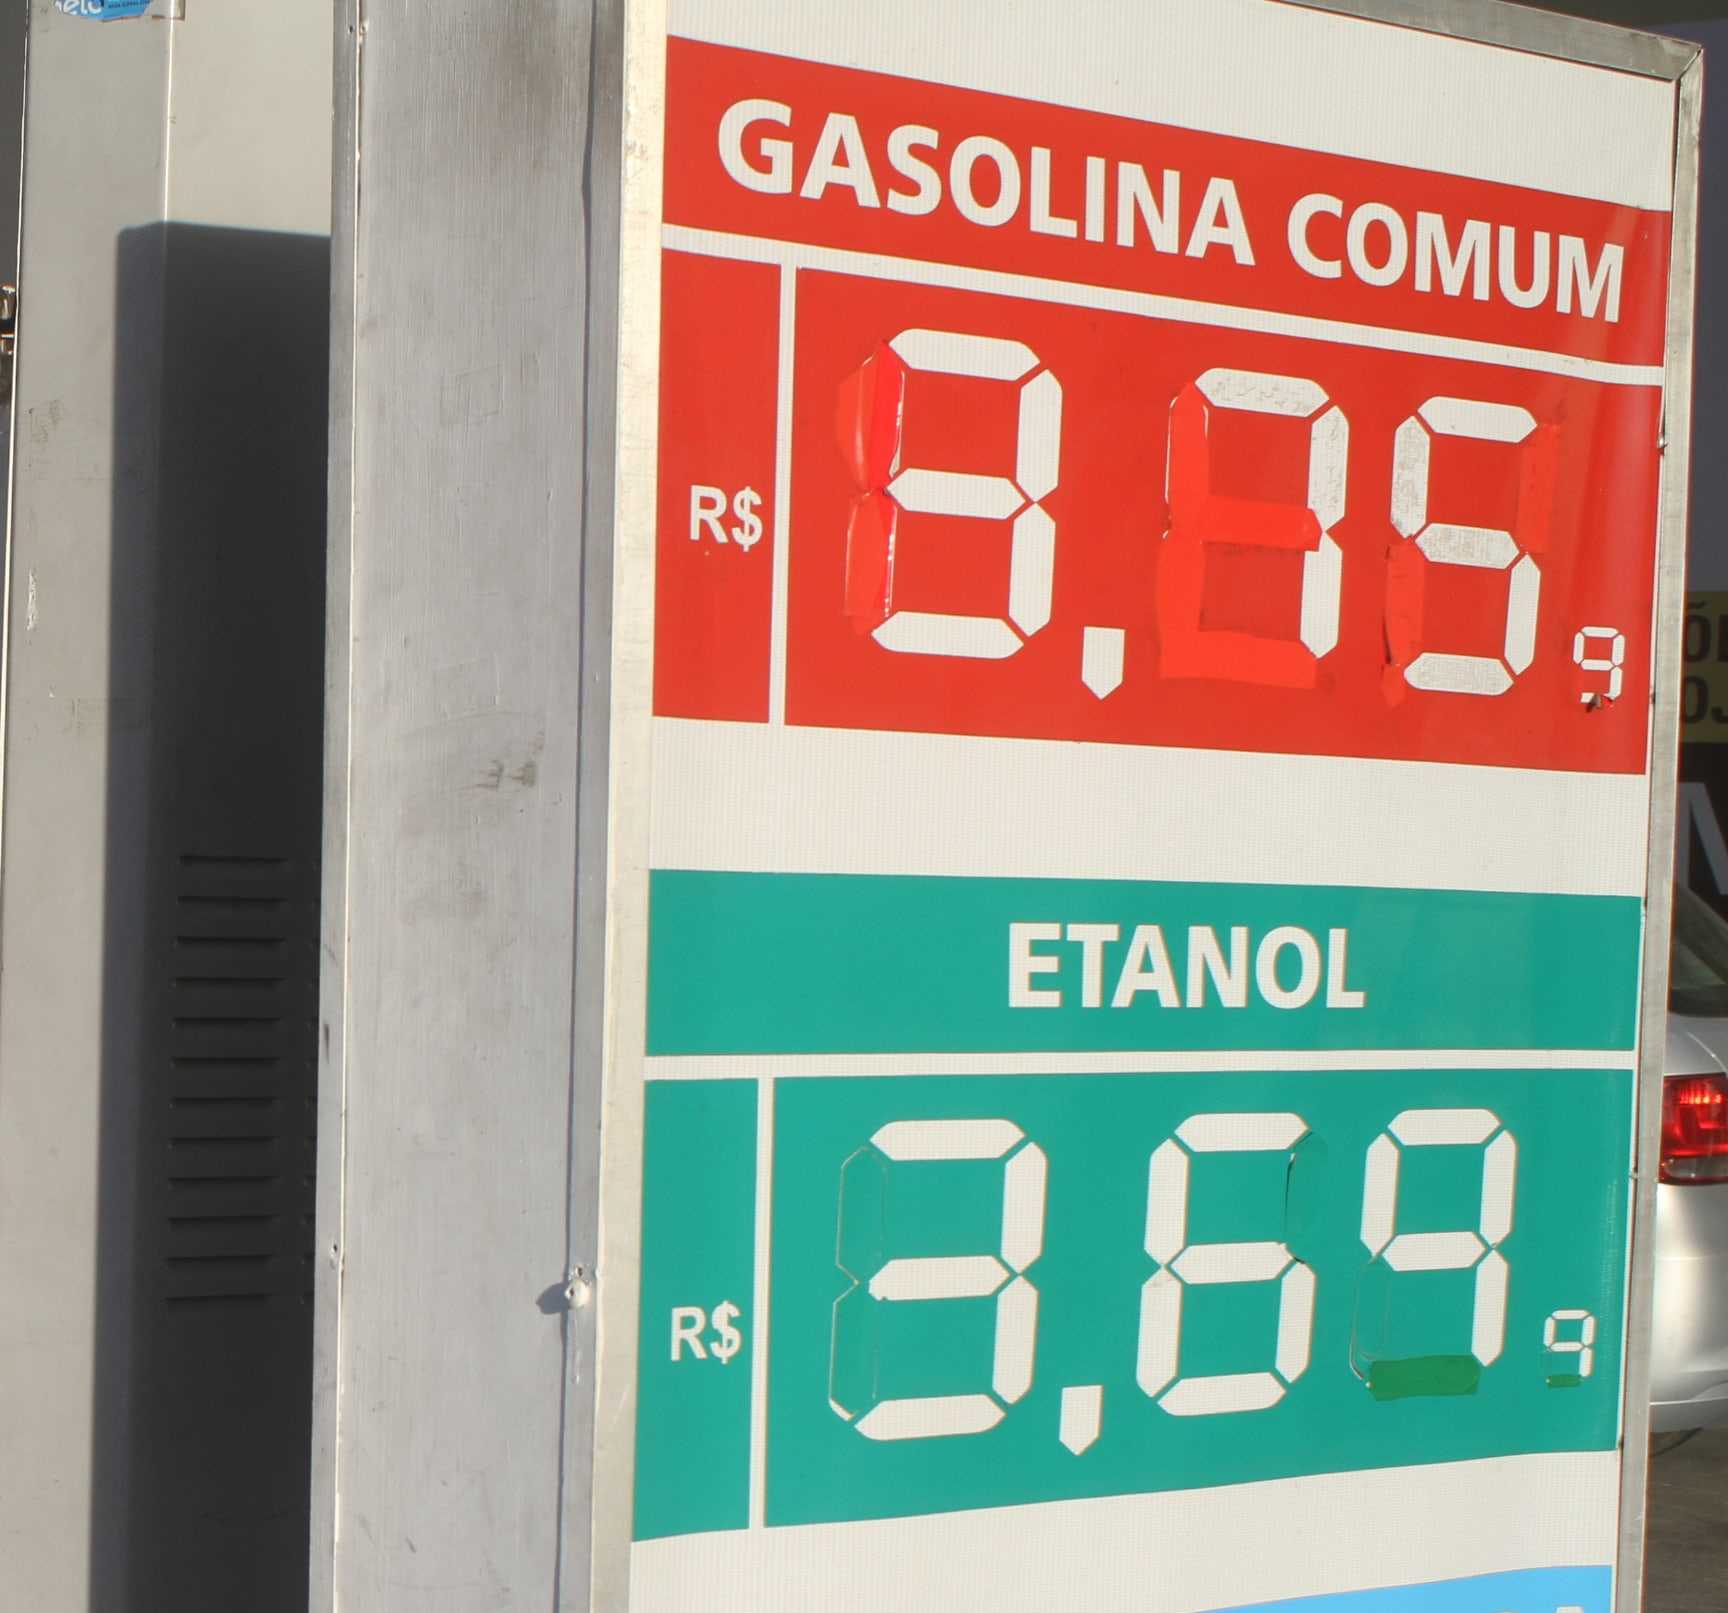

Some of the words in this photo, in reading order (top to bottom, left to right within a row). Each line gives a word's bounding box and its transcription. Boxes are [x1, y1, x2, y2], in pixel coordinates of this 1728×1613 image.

[718, 97, 1257, 267] GASOLINA
[1287, 193, 1625, 324] COMUM
[687, 484, 763, 552] R$
[1572, 626, 1625, 704] 9
[1007, 922, 1366, 1011] ETANOL
[669, 1299, 741, 1365] R$
[1543, 1310, 1595, 1378] 9
